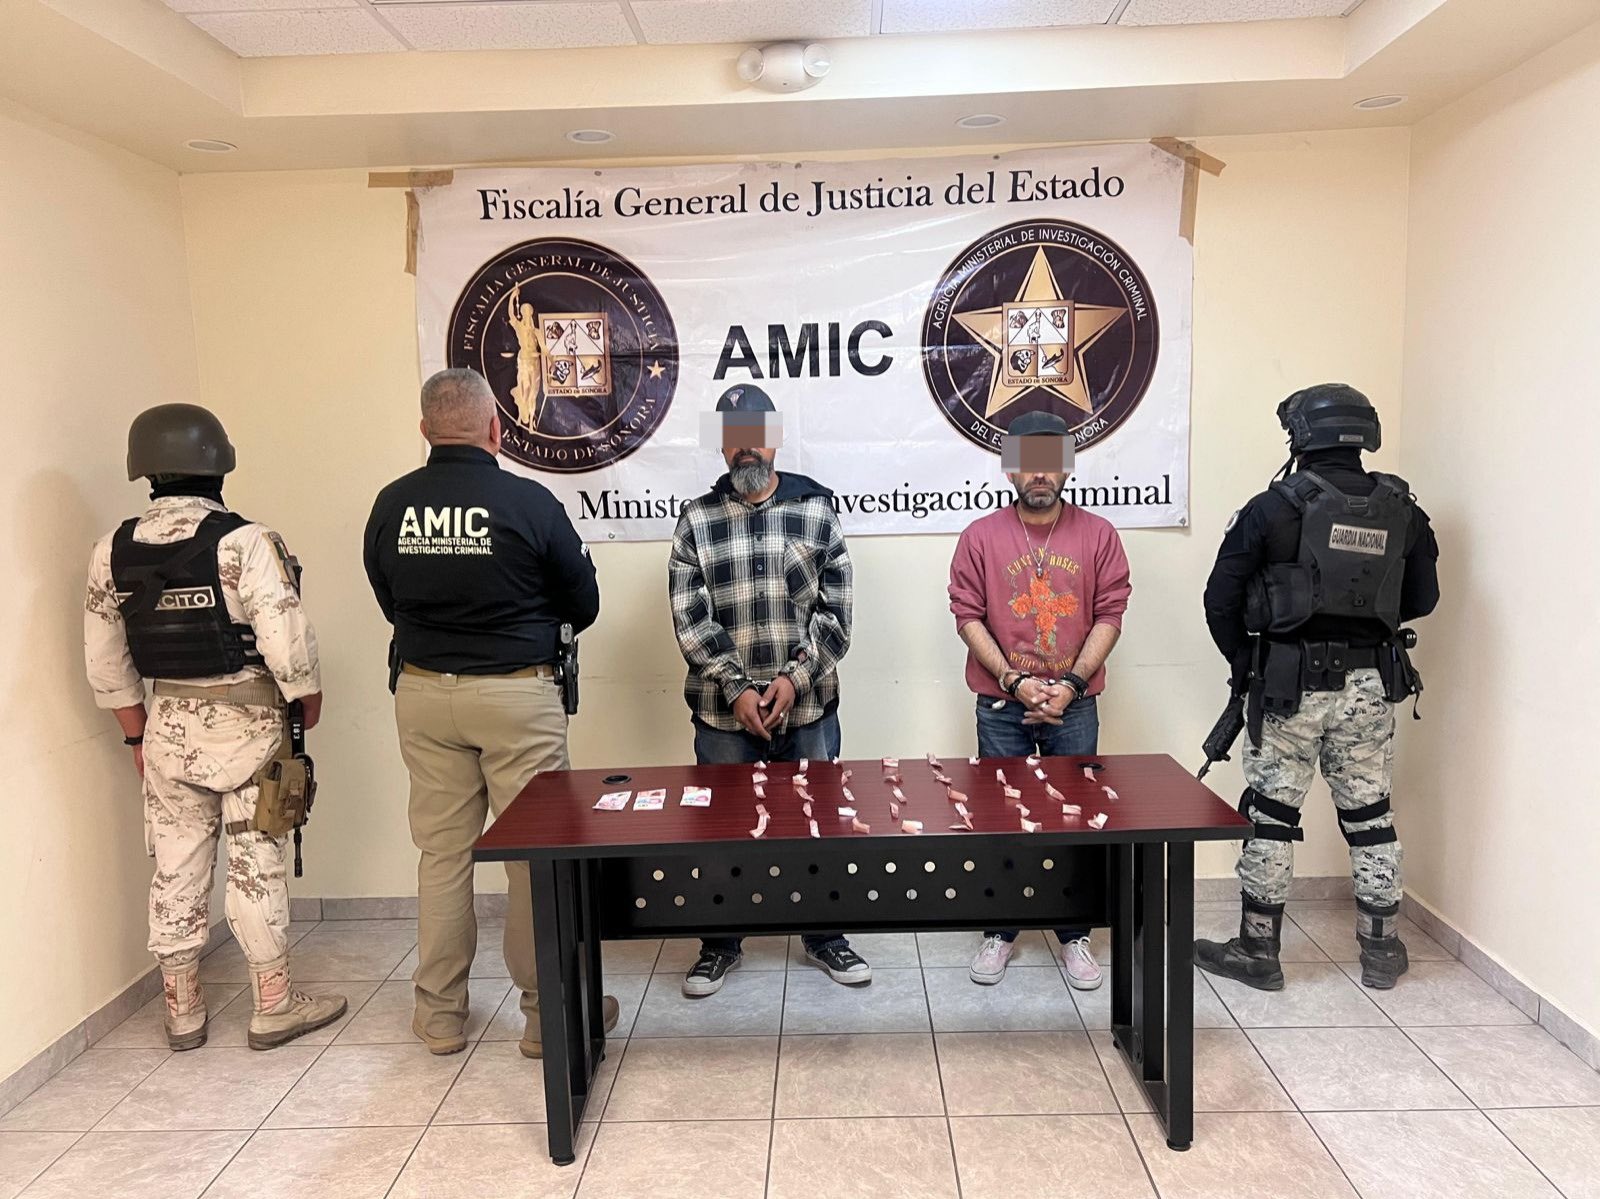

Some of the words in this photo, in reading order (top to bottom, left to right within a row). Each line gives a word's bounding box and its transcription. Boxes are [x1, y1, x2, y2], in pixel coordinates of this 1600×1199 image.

[477, 187, 603, 220] Fiscalía
[614, 183, 749, 217] General
[759, 181, 800, 212] de
[807, 175, 934, 217] Justicia
[944, 171, 996, 205] del
[1007, 167, 1125, 203] Estado
[932, 279, 962, 329] AGENCIA
[957, 234, 1018, 278] MINISTERIAL
[1021, 229, 1035, 242] DE
[1039, 228, 1121, 271] INVESTIGACIÓN
[1119, 269, 1148, 321] CRIMINAL
[505, 255, 585, 280] GENERAL
[589, 262, 612, 280] DE
[612, 278, 660, 351] JUSTICIA
[712, 319, 894, 380] AMIC
[502, 429, 568, 460] ESTADO
[574, 444, 598, 460] DE
[600, 398, 656, 452] SONORA
[970, 420, 988, 440] DEL
[1075, 417, 1109, 443] NORA
[577, 488, 692, 520] Ministe
[832, 480, 1015, 519] nvestigación
[1063, 474, 1173, 507] iminal
[398, 537, 430, 545] AGENCIA
[431, 537, 479, 546] MINISTERIAL
[480, 537, 492, 546] DE
[399, 506, 490, 538] AMIC
[1332, 528, 1358, 546] GUARDIA
[1357, 531, 1385, 550] NACIONAL
[455, 546, 493, 555] CRIMINAL
[161, 592, 209, 607] CITO
